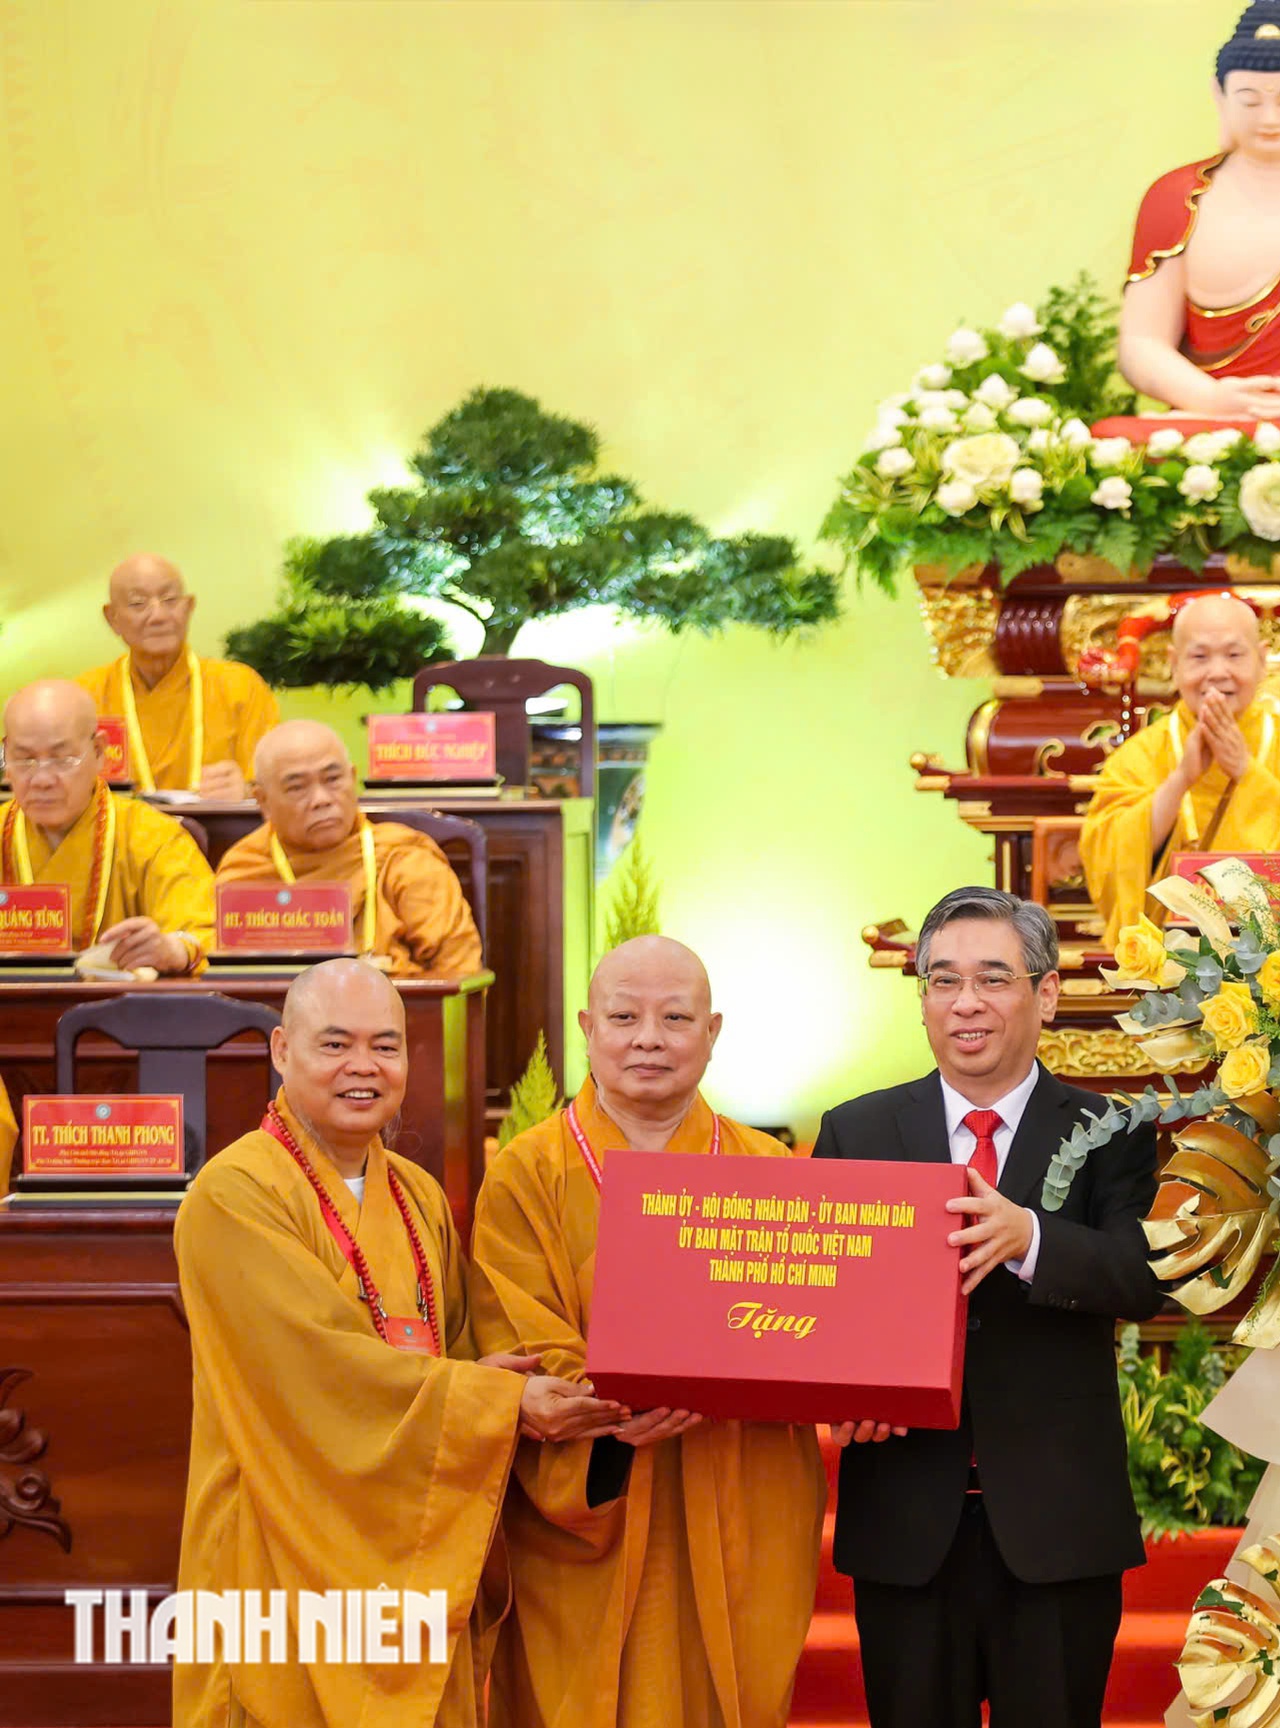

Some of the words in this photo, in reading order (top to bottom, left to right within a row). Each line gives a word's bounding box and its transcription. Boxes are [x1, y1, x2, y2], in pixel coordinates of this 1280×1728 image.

[246, 907, 280, 928] THÍCH
[282, 907, 311, 928] GIÁC
[32, 1125, 50, 1145] TT.
[52, 1119, 88, 1145] THÍCH
[91, 1125, 131, 1145] THANH
[133, 1125, 175, 1145] PHONG
[642, 1189, 677, 1216] THÀNH
[679, 1188, 694, 1217] ỦY
[702, 1192, 721, 1223] HỘI
[754, 1195, 785, 1222] NHÂN
[787, 1196, 809, 1223] DÂN
[819, 1194, 833, 1224] ỦY
[834, 1202, 858, 1225] BAN
[859, 1200, 890, 1227] NHÂN
[892, 1201, 915, 1228] DÂN
[679, 1219, 694, 1248] ỦY
[695, 1227, 718, 1249] BAN
[720, 1224, 744, 1256] MẶT
[745, 1226, 774, 1257] TRẬN
[776, 1223, 791, 1254] TỔ
[791, 1225, 820, 1256] QUỐC
[822, 1229, 845, 1261] VIỆT
[846, 1234, 872, 1258] NAM
[709, 1255, 744, 1282] THÀNH
[746, 1254, 769, 1284] PHỐ
[787, 1260, 807, 1286] CHÍ
[808, 1263, 838, 1287] MINH
[727, 1301, 817, 1340] Tặng
